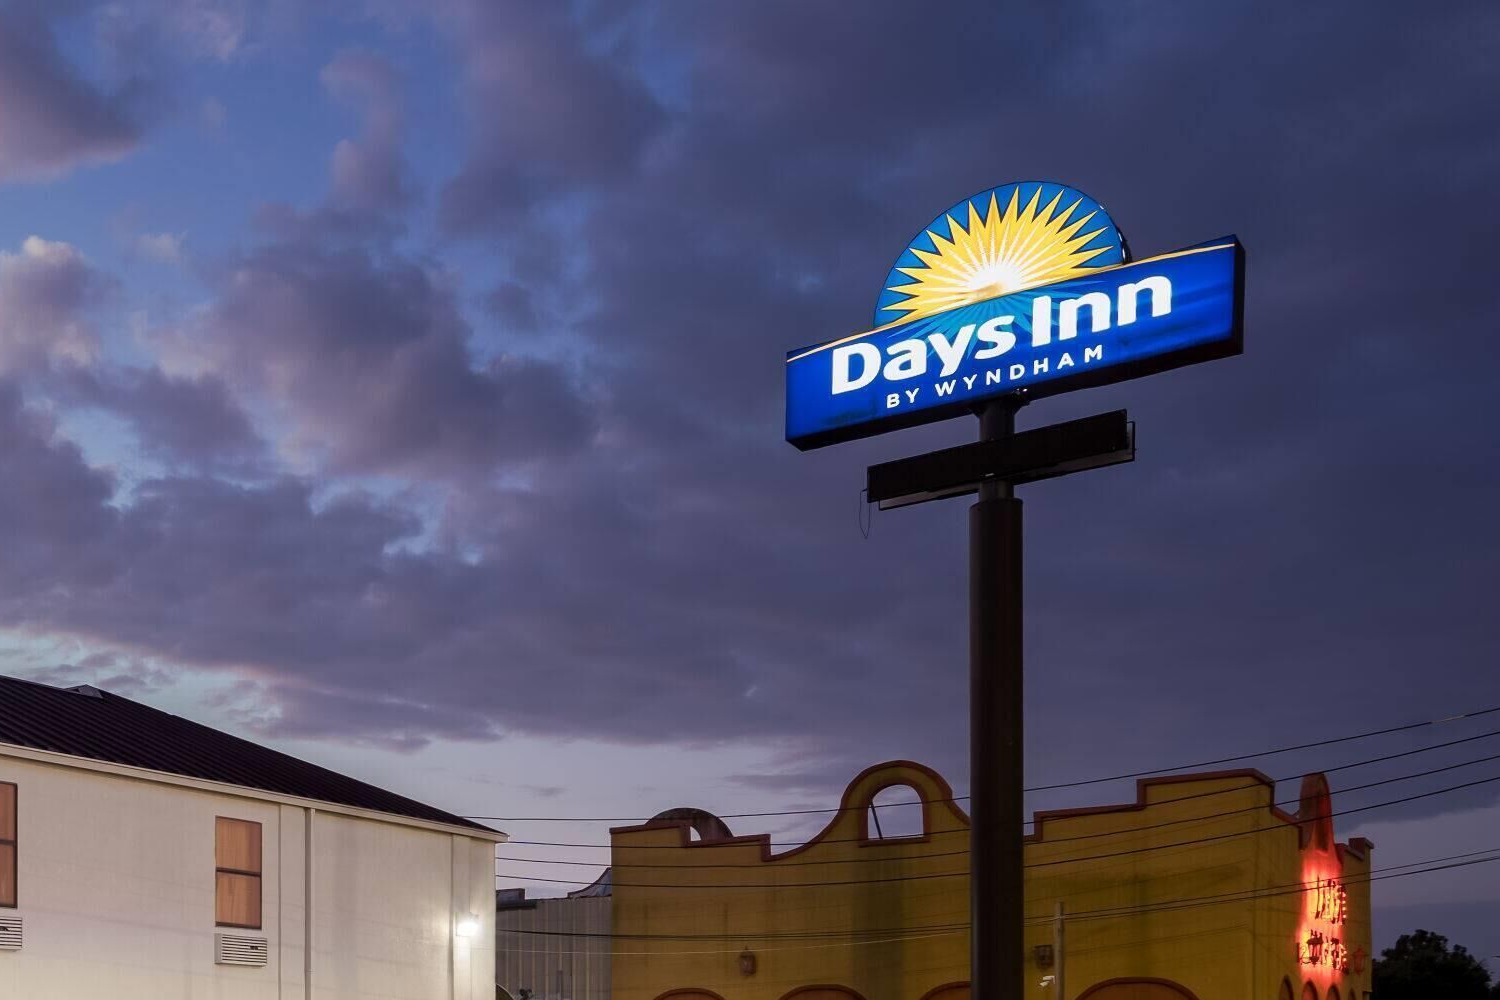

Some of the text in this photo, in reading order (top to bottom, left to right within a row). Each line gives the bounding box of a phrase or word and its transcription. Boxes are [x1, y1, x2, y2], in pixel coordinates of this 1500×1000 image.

[831, 275, 1172, 395] Days Inn
[886, 344, 1104, 409] BY WYNDHAM
